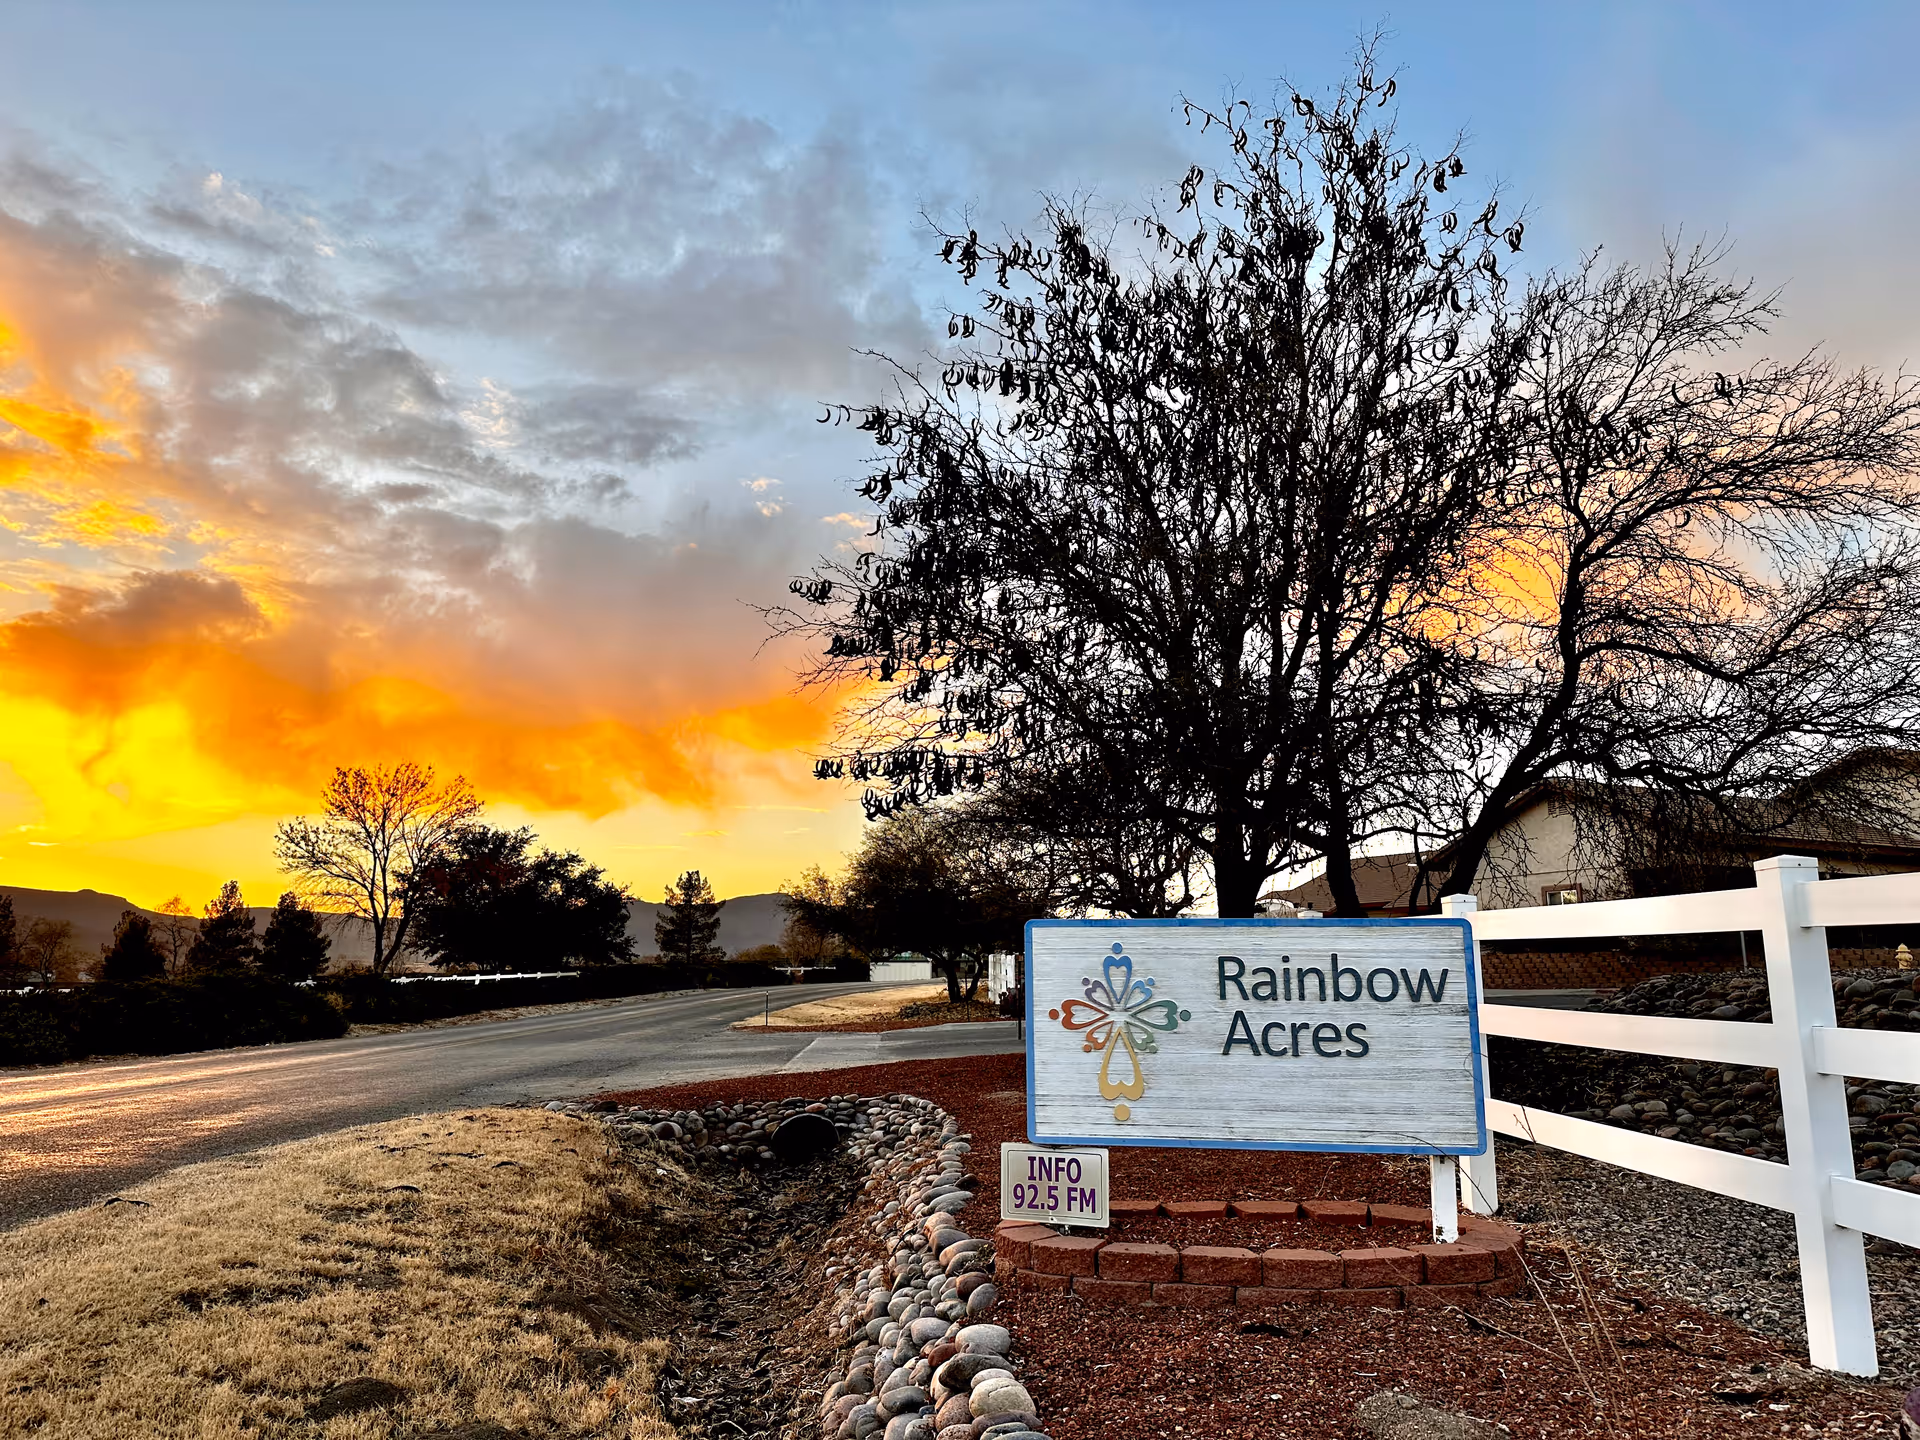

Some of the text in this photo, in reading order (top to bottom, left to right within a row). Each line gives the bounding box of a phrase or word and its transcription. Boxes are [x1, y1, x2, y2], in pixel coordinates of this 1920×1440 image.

[1217, 953, 1449, 1002] Rainbow
[1222, 1010, 1370, 1058] Acres
[1027, 1156, 1082, 1184] INFO
[1013, 1183, 1097, 1213] 92.5 FM
